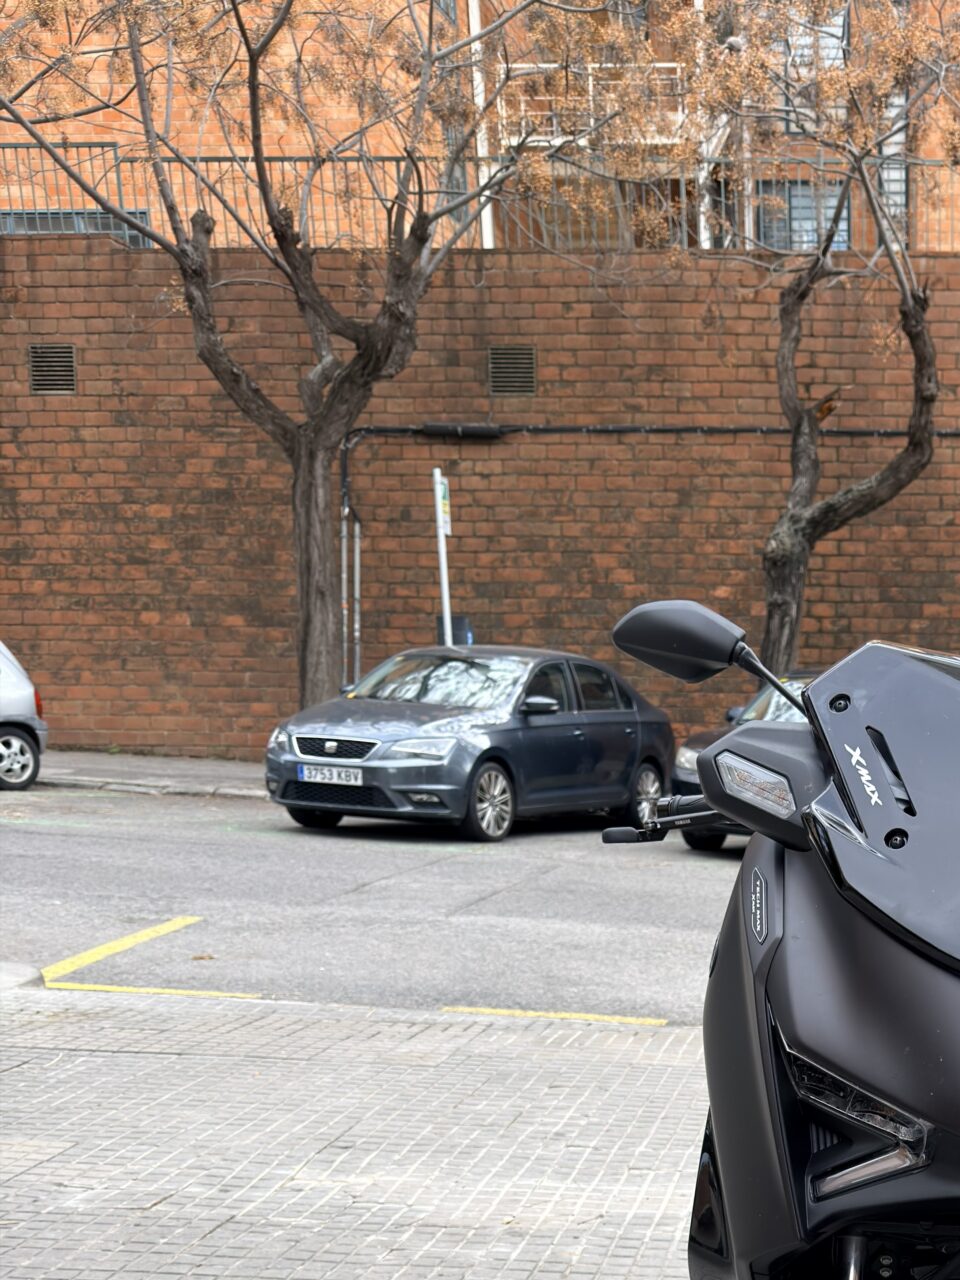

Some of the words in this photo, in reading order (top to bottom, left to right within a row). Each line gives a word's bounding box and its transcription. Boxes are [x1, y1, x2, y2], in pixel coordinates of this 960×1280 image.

[305, 766, 334, 781] 3753
[336, 769, 361, 783] KBV
[844, 743, 883, 806] XMAX
